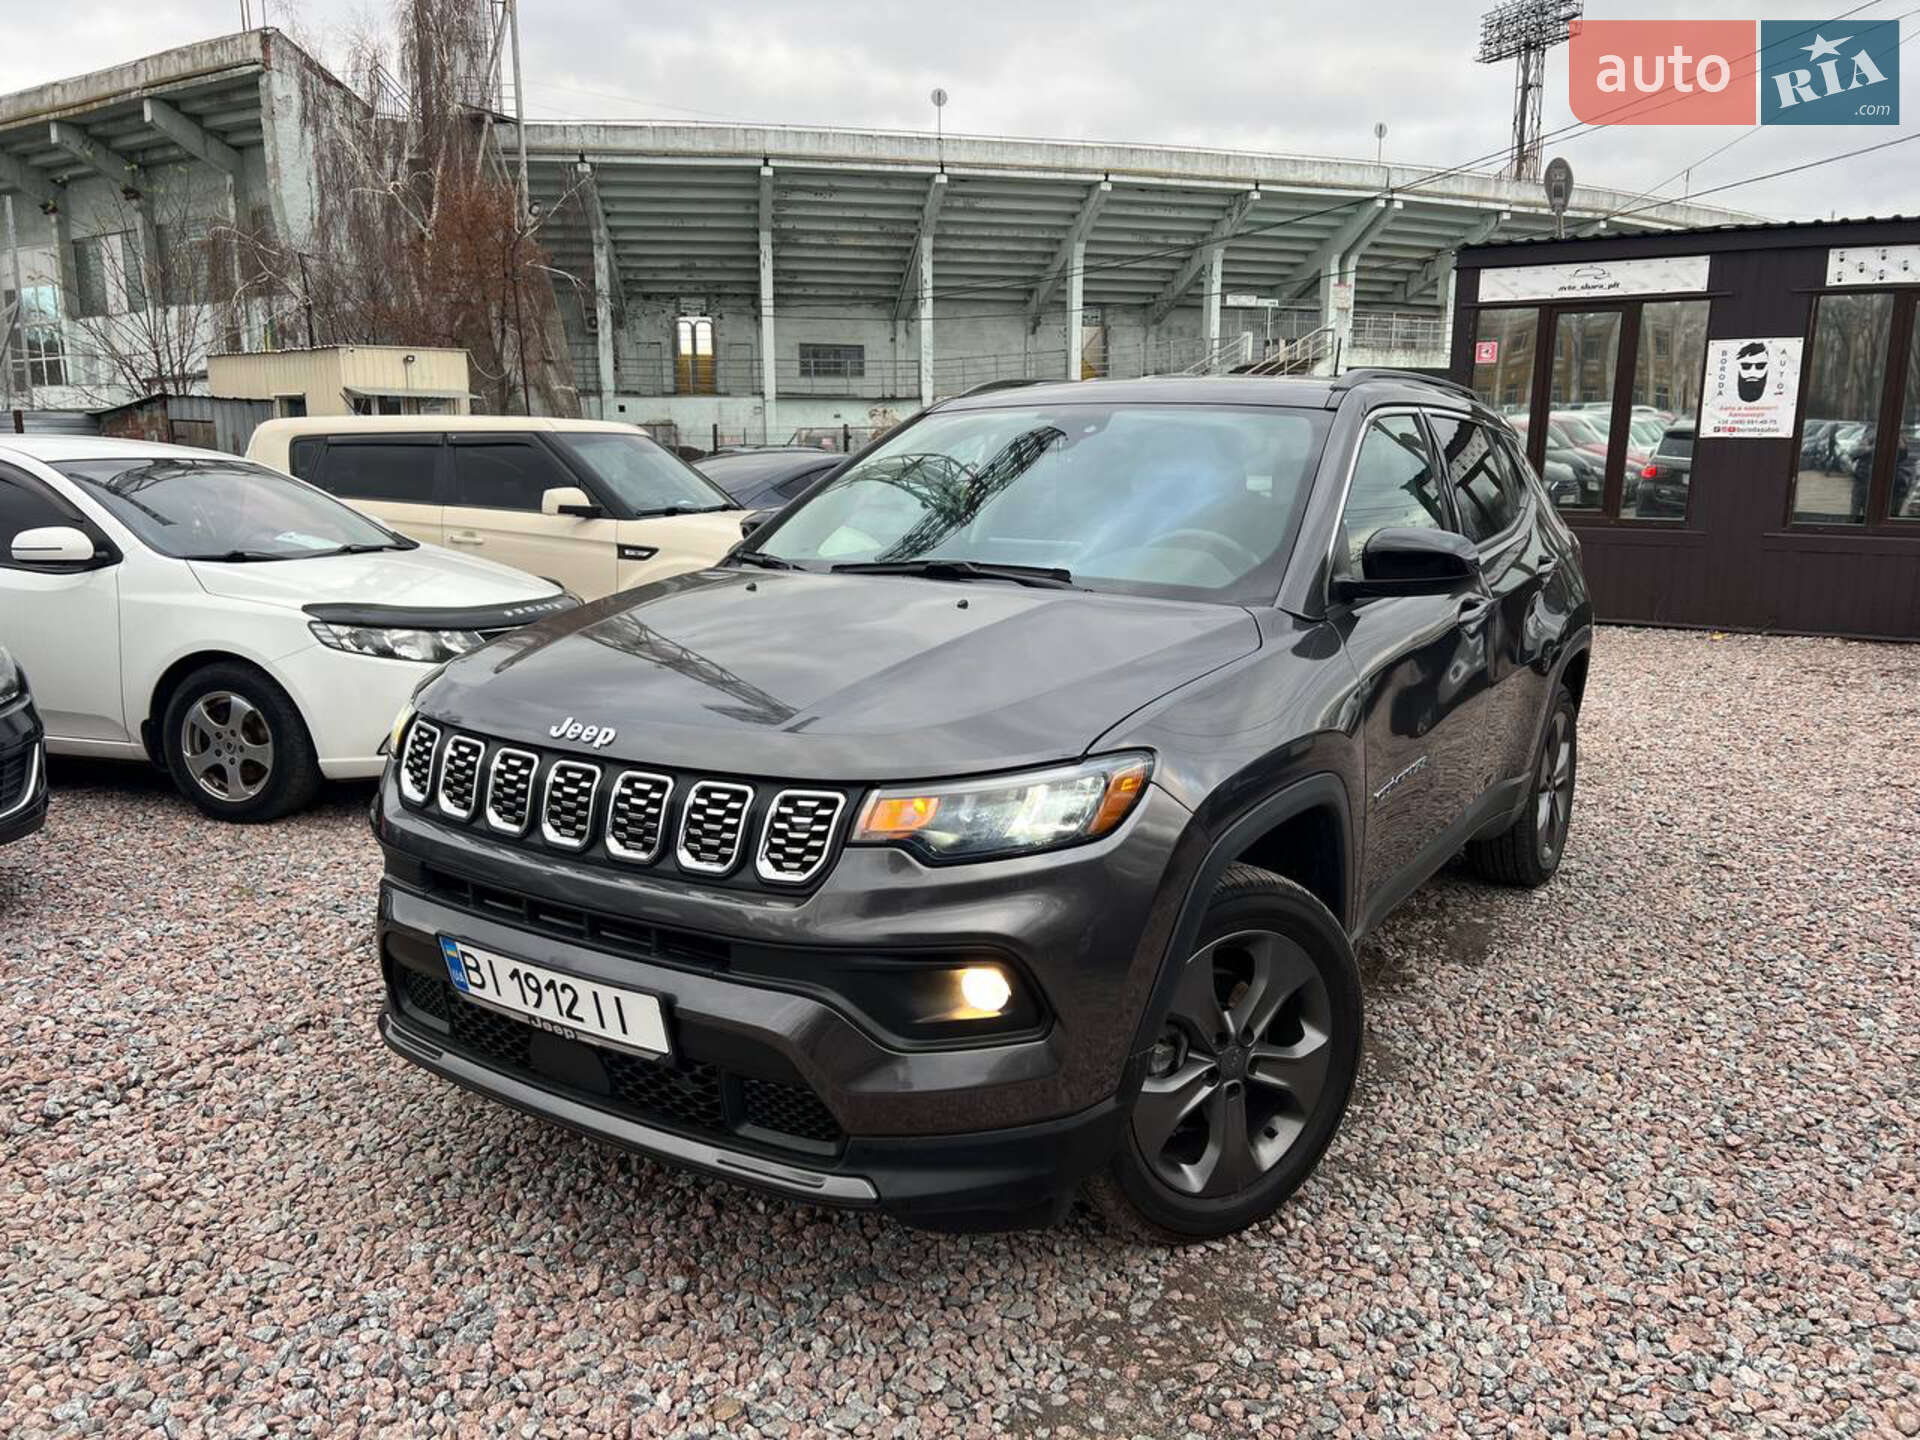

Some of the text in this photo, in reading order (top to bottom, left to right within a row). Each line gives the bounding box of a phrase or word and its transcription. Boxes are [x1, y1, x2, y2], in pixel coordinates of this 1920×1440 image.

[1716, 350, 1728, 397] BORODA
[1776, 348, 1787, 390] AUTO
[549, 716, 617, 750] Jeep
[508, 967, 585, 1023] 1912
